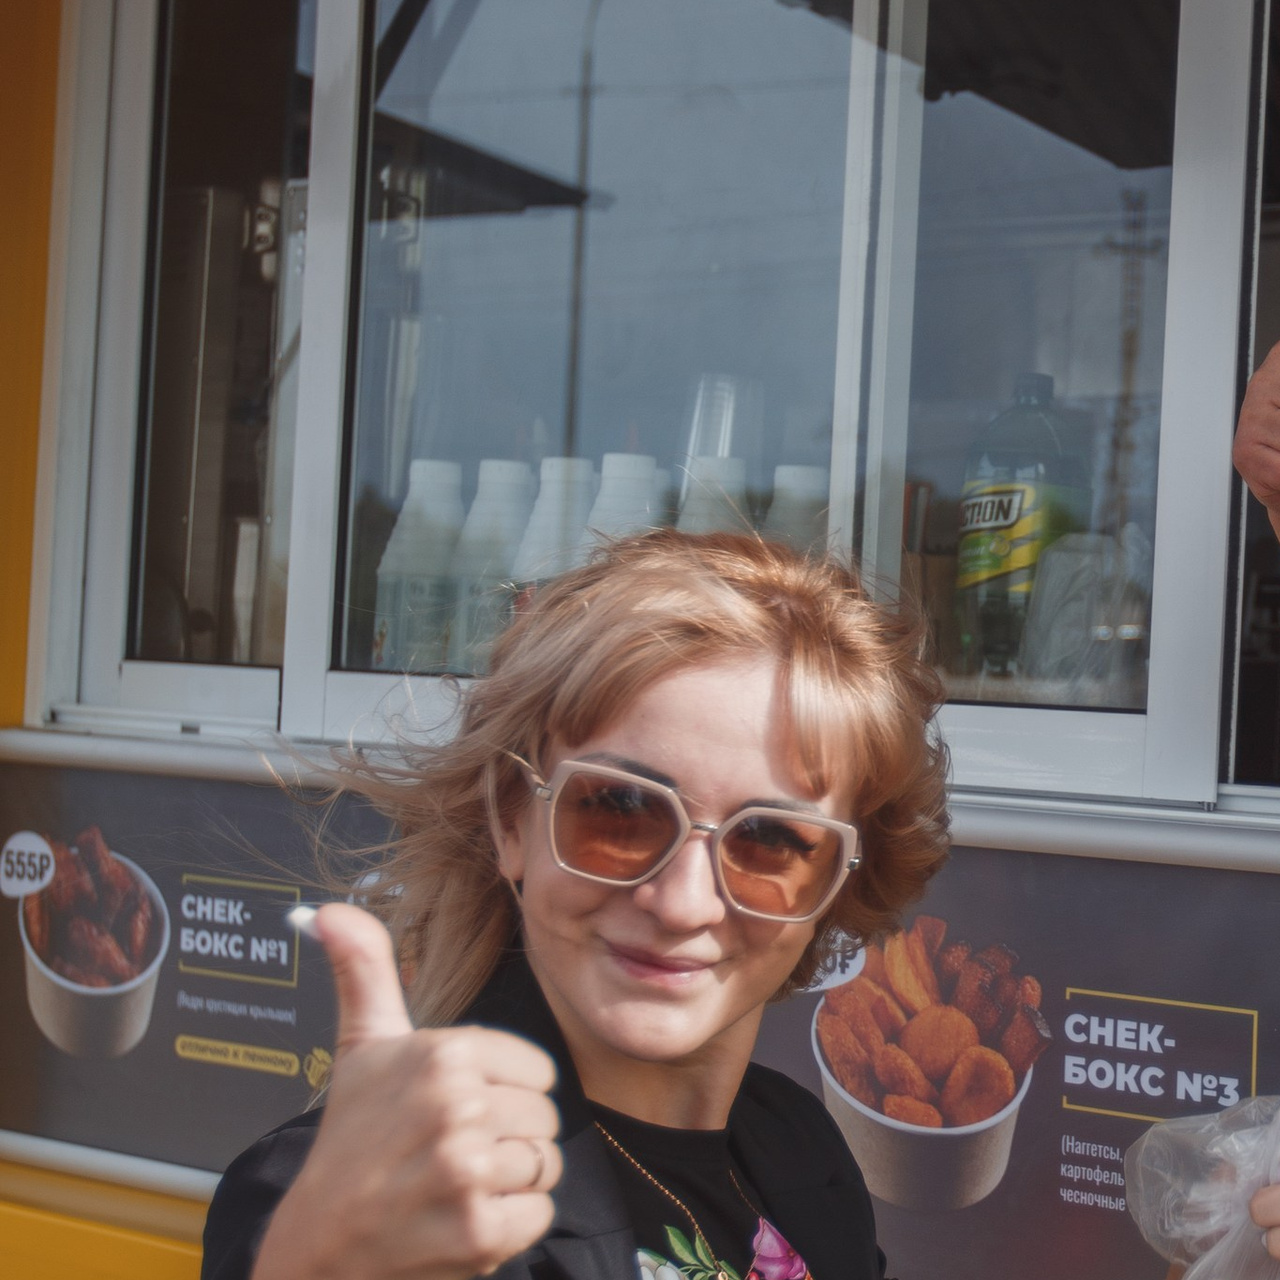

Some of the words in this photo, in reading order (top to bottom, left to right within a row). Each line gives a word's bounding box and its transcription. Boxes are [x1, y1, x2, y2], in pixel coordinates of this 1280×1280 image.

[181, 894, 252, 925] СНЕК-
[180, 927, 244, 960] БОКС
[250, 936, 288, 966] №1
[1064, 1013, 1176, 1054] СНЕК-
[1064, 1055, 1166, 1097] БОКС
[1176, 1070, 1240, 1107] №3
[1061, 1134, 1124, 1164] (Наггетсы,
[1060, 1163, 1125, 1187] картофель
[1060, 1187, 1126, 1212] чесночные
